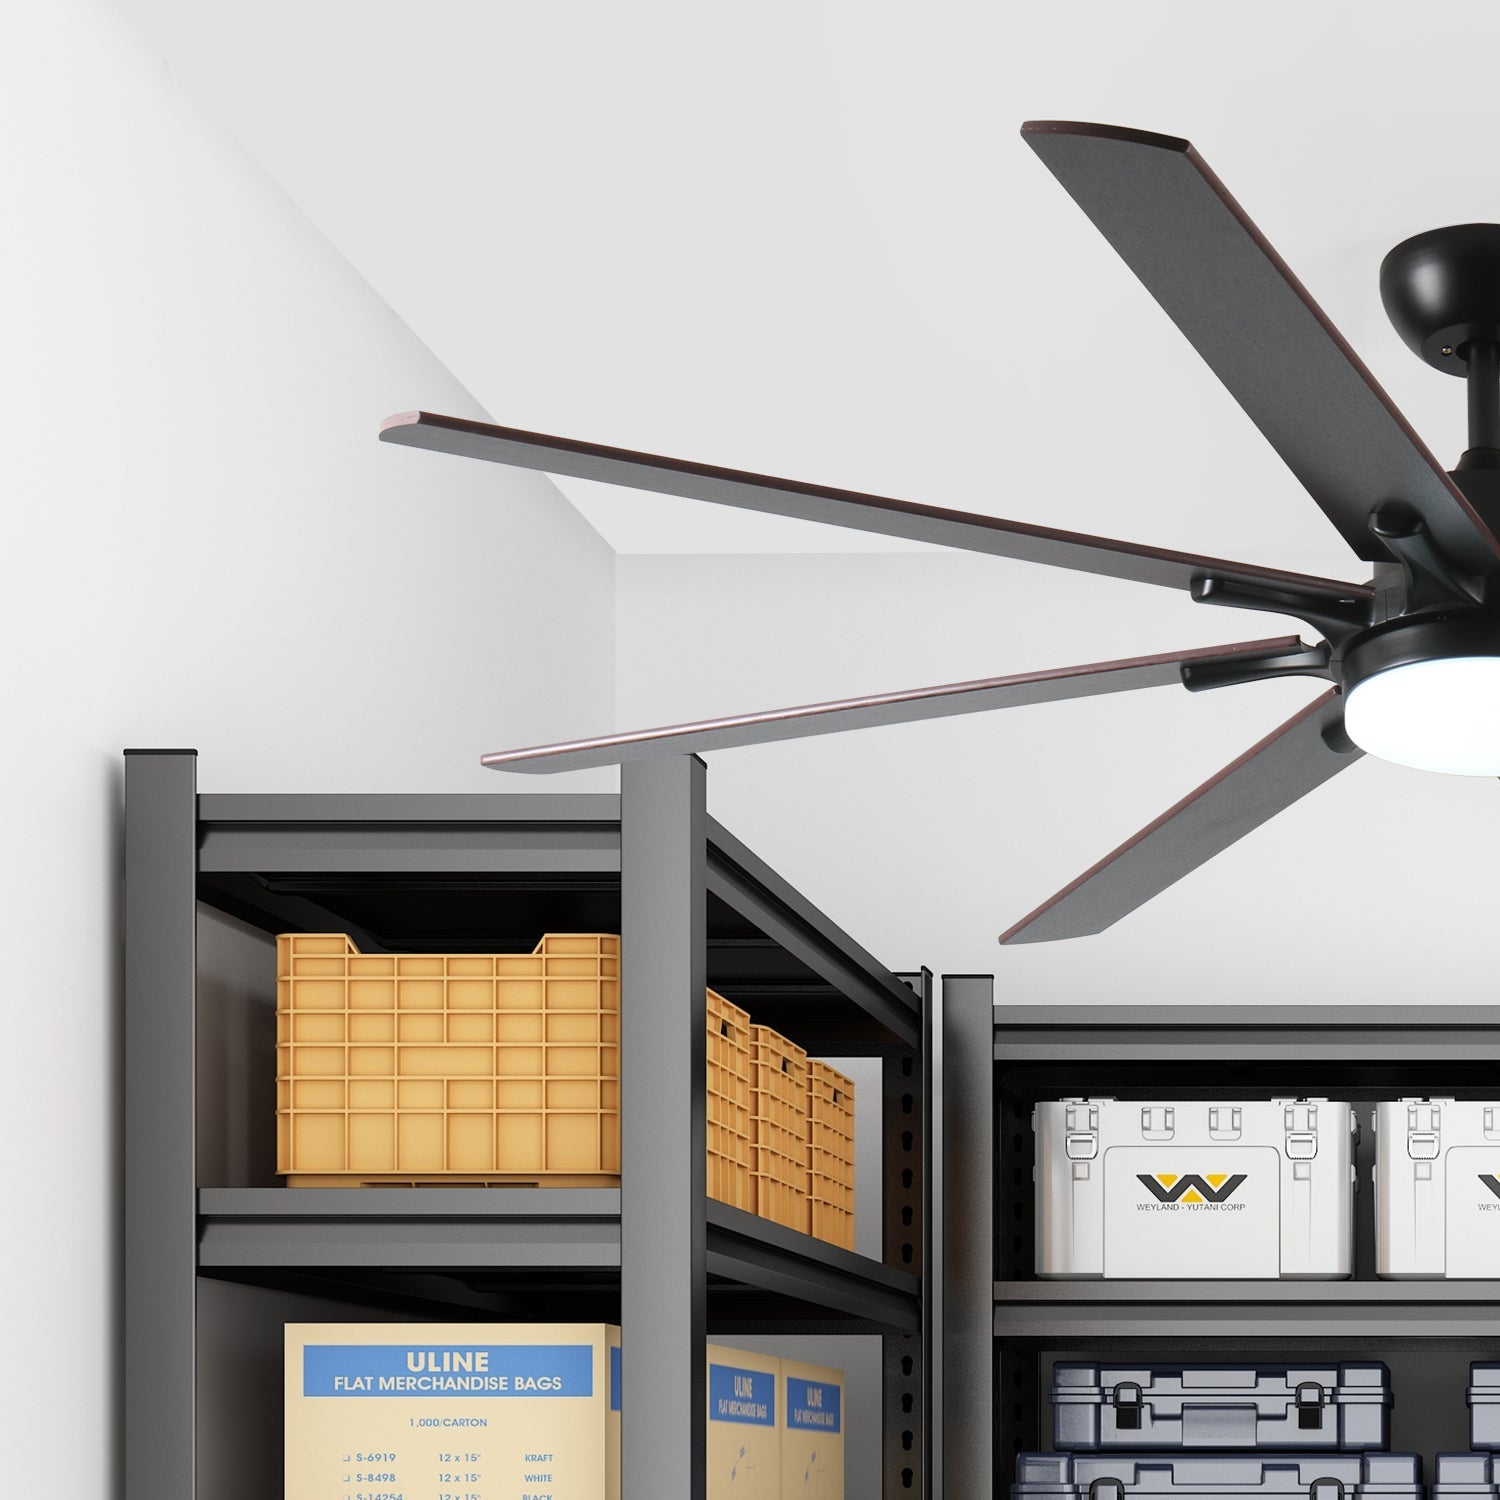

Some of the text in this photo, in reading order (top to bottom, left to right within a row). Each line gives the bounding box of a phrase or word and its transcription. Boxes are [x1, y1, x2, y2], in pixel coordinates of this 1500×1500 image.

[1136, 1203, 1246, 1212] WEYLAND YUTANI CORP
[407, 1351, 489, 1373] ULINE
[334, 1376, 562, 1391] FLAT MERCHANDISE BAGS
[734, 1375, 752, 1399] ULINE
[807, 1387, 822, 1408] ULINE
[356, 1452, 397, 1463] S-6919
[438, 1453, 452, 1463] 12
[524, 1454, 554, 1463] KRAFT
[356, 1473, 397, 1483] S-8498
[438, 1473, 452, 1483] 12
[523, 1473, 553, 1483] WHITE
